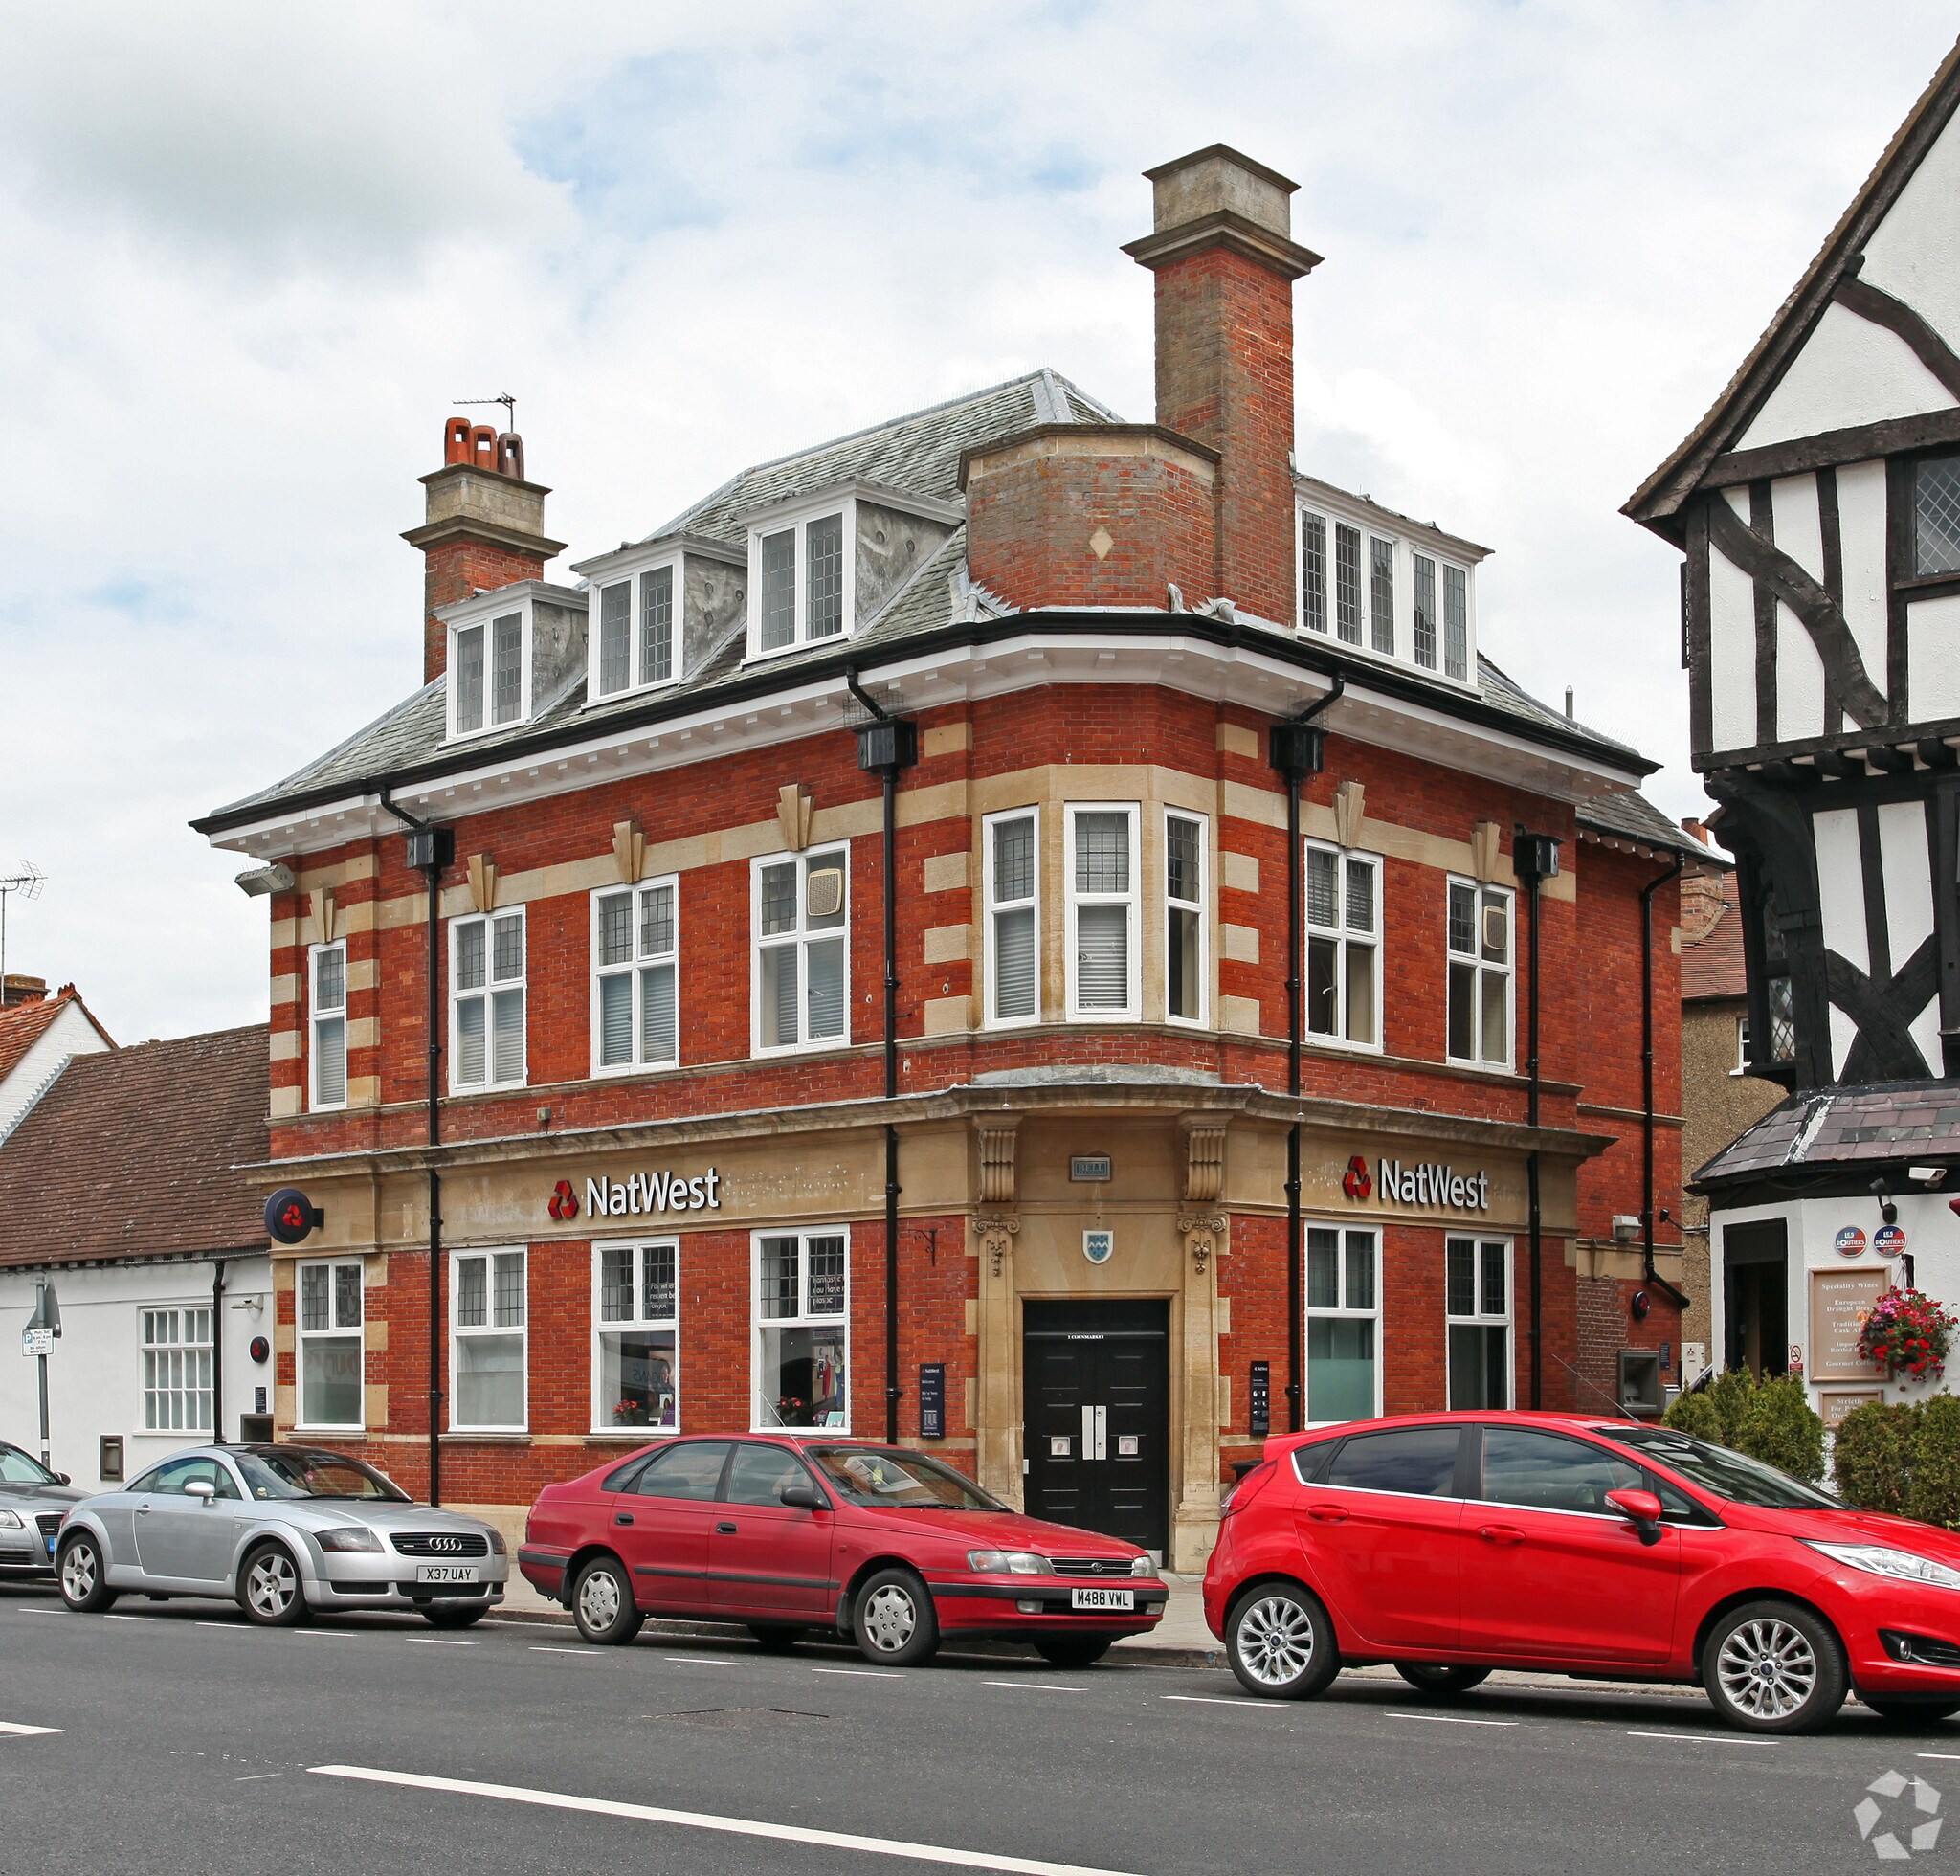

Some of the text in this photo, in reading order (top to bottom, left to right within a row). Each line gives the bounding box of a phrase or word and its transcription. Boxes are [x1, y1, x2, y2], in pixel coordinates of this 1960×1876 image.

[1379, 1158, 1489, 1210] NatWest
[586, 1167, 720, 1217] NatWest
[1821, 1283, 1855, 1291] Speciality
[426, 1568, 472, 1580] X37 UAY
[1077, 1591, 1129, 1606] M488 VWL
